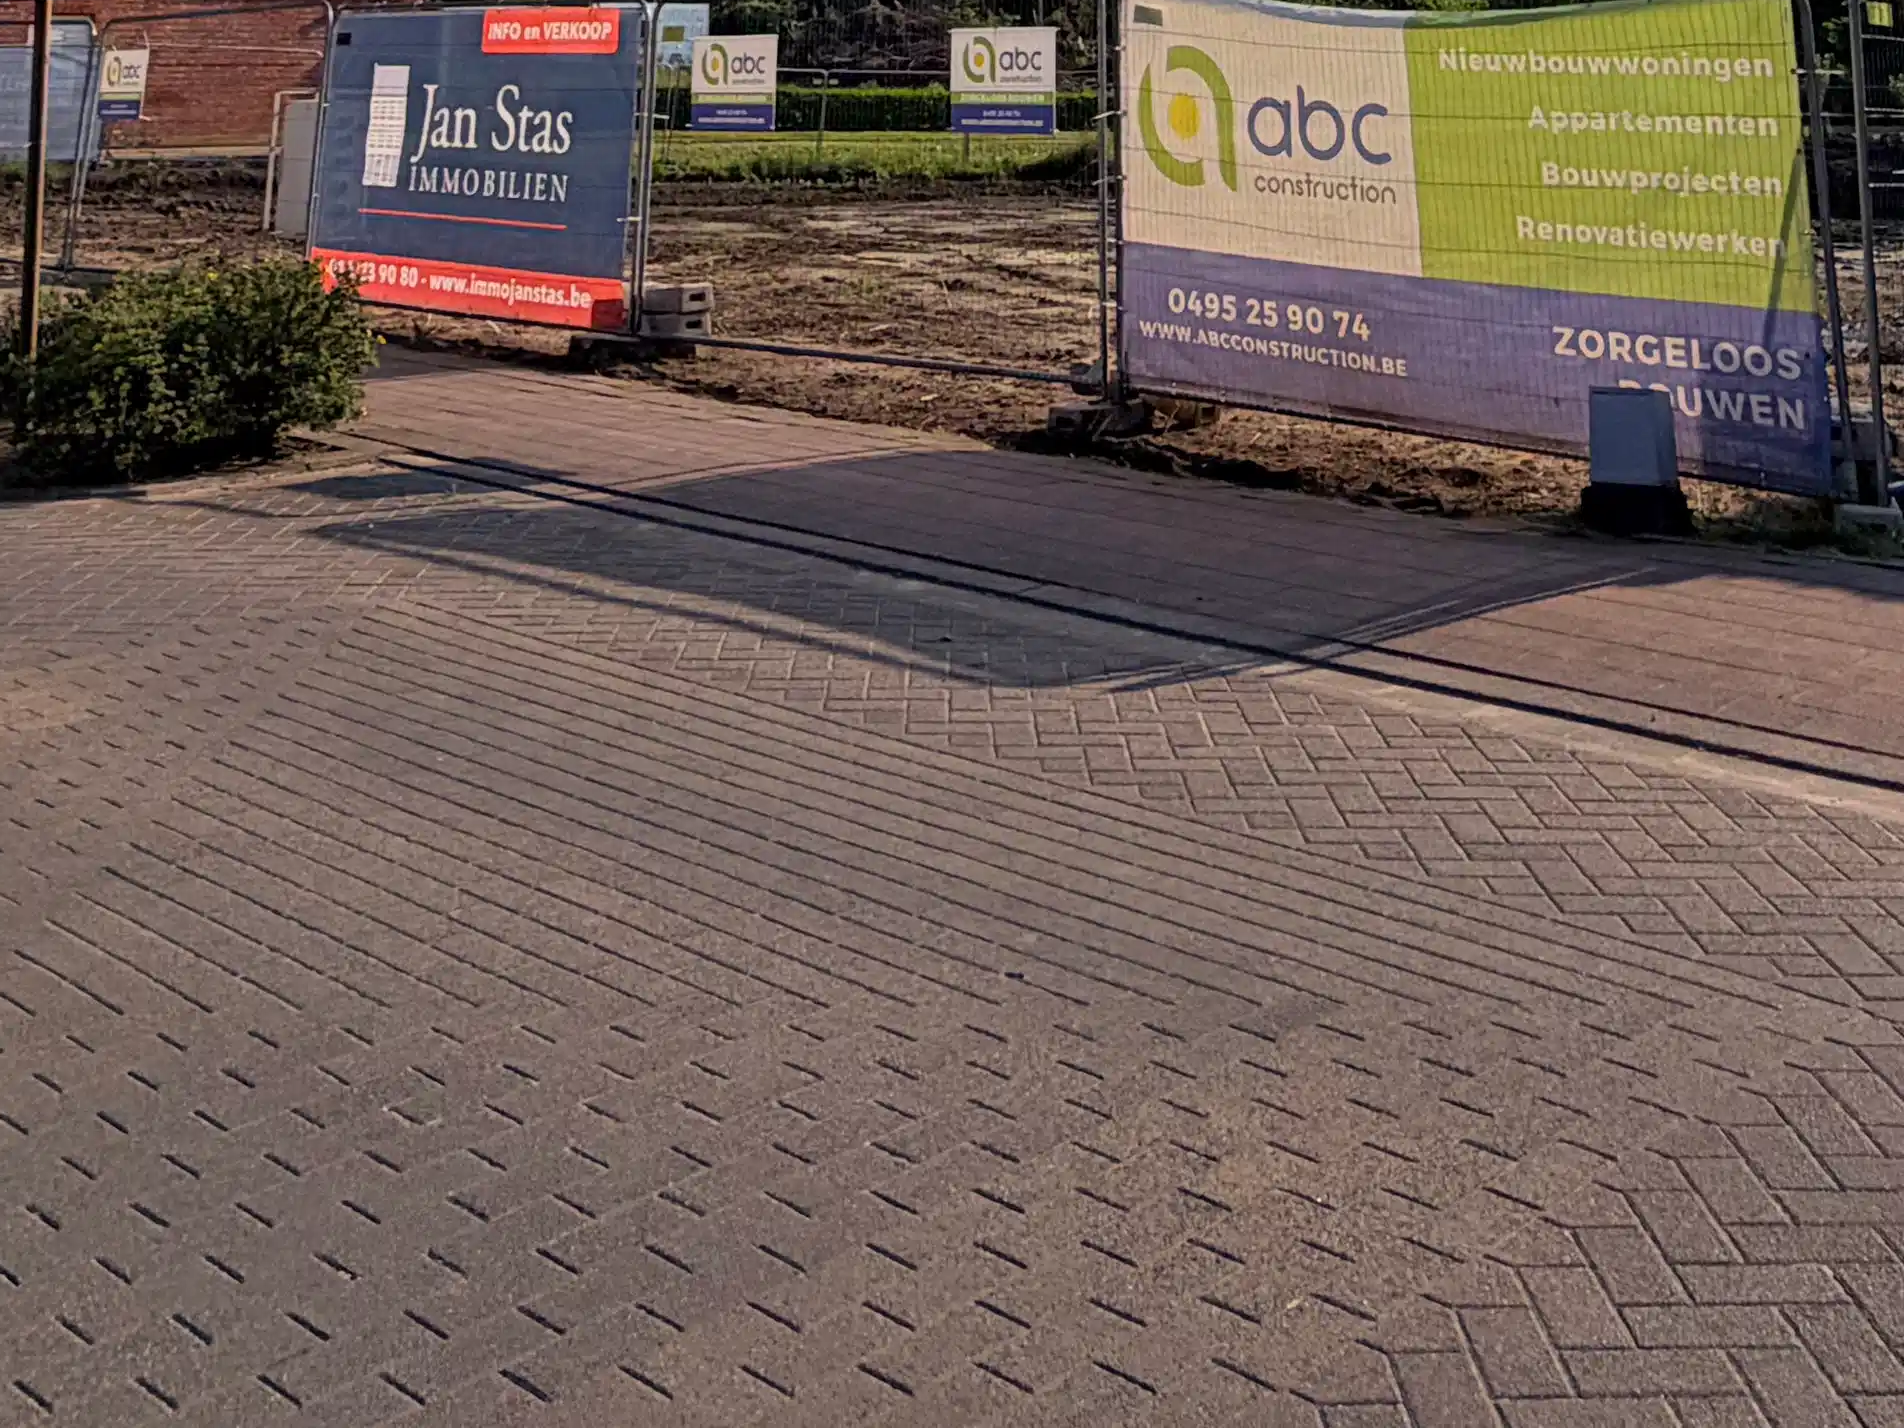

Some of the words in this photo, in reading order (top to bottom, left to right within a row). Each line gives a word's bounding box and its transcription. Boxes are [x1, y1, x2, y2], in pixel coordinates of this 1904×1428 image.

[488, 22, 521, 40] INFO
[524, 26, 540, 40] en
[543, 22, 612, 40] VERKOOP
[731, 52, 765, 74] abc
[999, 46, 1042, 71] abc
[1439, 48, 1773, 82] Nieuwbouwwoningen
[410, 84, 477, 163] Jan
[491, 84, 573, 154] Stas
[1247, 84, 1392, 165] abc
[1528, 105, 1778, 137] Appartementen
[409, 166, 569, 202] IMMOBILIEN
[1254, 173, 1396, 204] construction
[1541, 161, 1782, 198] Bouwprojecten
[1516, 215, 1786, 257] Renovatiewerken
[379, 263, 397, 285] 90
[400, 265, 418, 288] 80
[429, 273, 592, 308] www.immojanstas.be
[1168, 288, 1237, 322] 0495
[1246, 298, 1278, 328] 25
[1287, 304, 1324, 335] 90
[1332, 311, 1371, 342] 74
[1139, 319, 1408, 377] WWW.ABCCONSTRUCTION.BE
[1552, 326, 1802, 380] ZORGELOOS
[1618, 379, 1805, 430] UWEN
